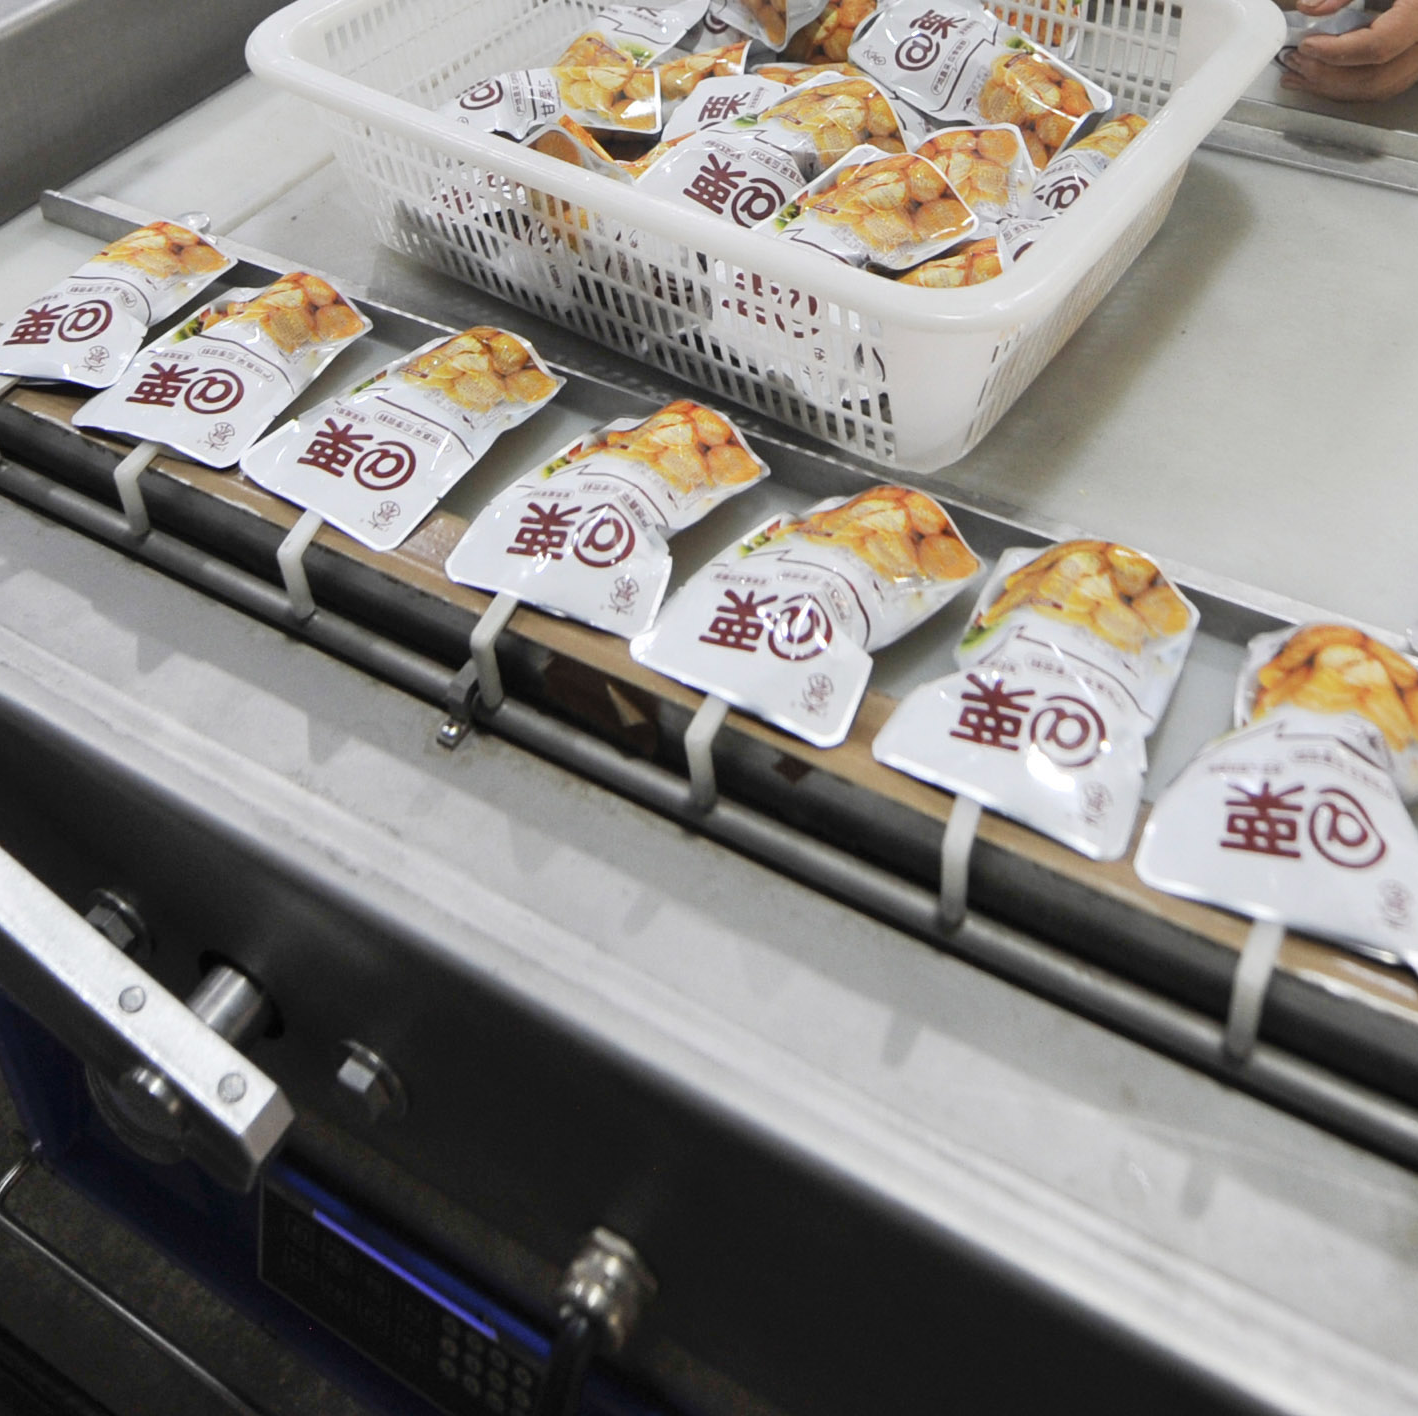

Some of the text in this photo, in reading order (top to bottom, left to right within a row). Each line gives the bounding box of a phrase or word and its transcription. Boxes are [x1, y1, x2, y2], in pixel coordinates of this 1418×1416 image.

[894, 8, 968, 71] @栗
[682, 152, 787, 229] @栗
[2, 299, 113, 346] @栗
[125, 361, 245, 415] @栗
[297, 417, 417, 491] @栗
[505, 501, 636, 568] @栗
[698, 588, 833, 661] @栗
[949, 672, 1107, 768] @栗
[1220, 781, 1387, 869] @栗
